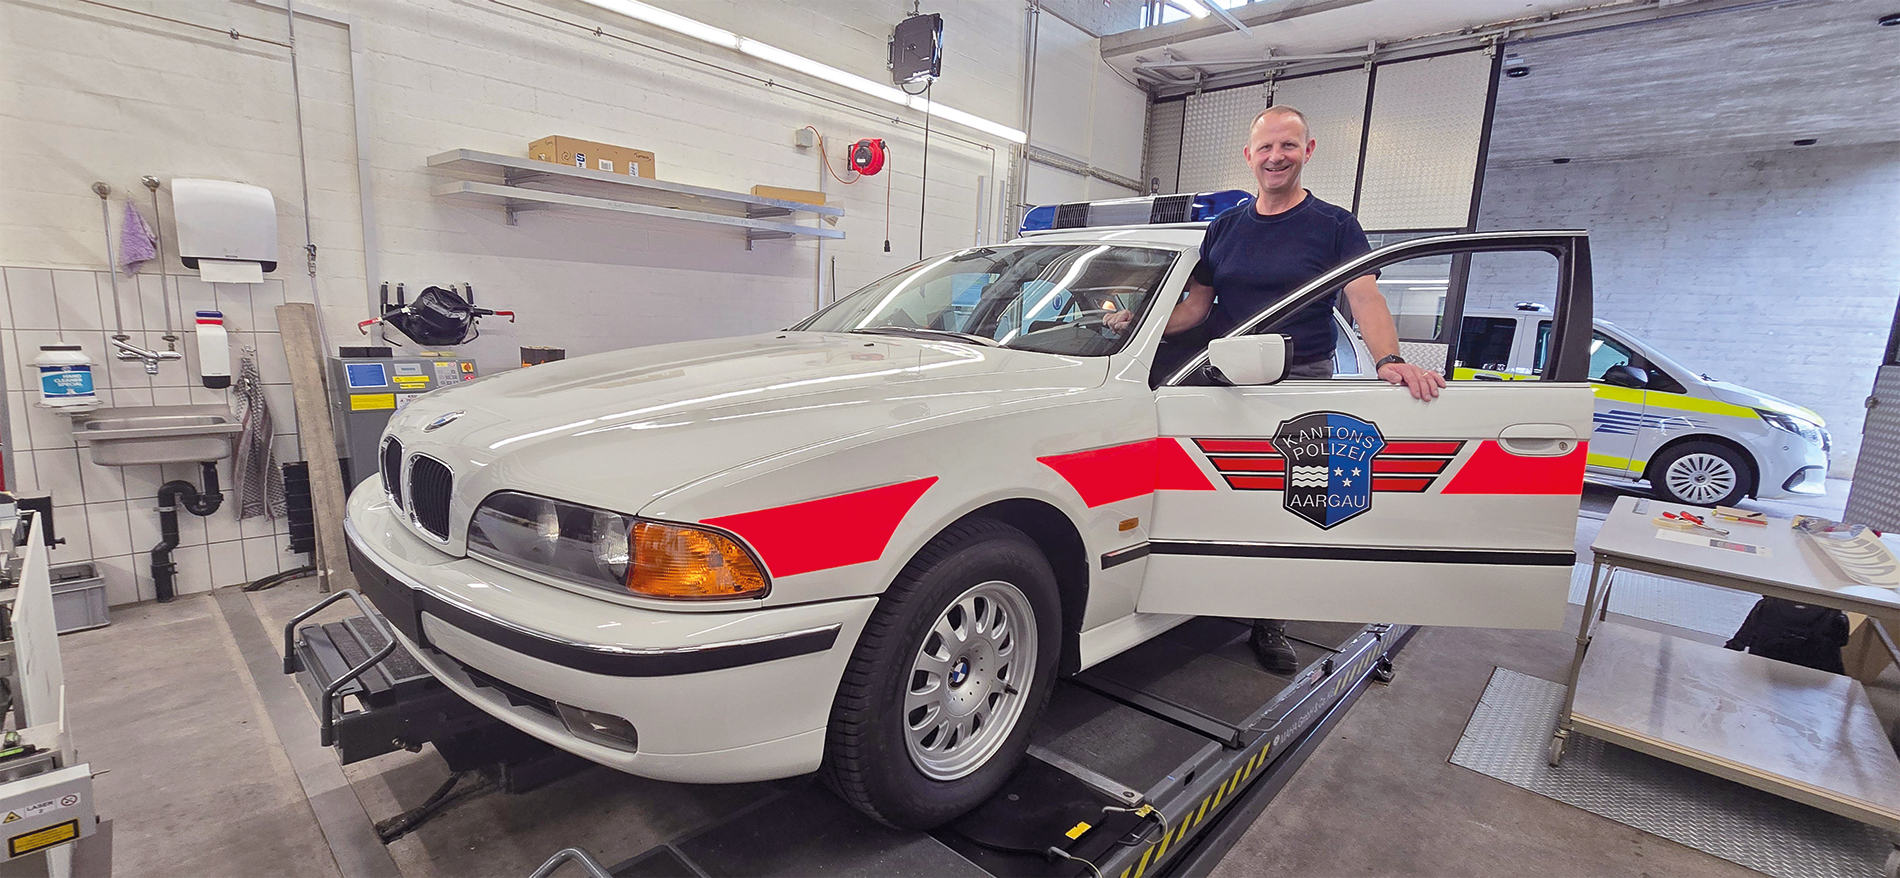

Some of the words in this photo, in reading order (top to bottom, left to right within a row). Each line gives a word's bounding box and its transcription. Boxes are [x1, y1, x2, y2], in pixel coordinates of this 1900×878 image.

[1282, 426, 1375, 449] KANTONS
[1292, 442, 1366, 462] POLIZEI
[1289, 493, 1366, 508] AARGAU
[26, 801, 54, 812] LASER
